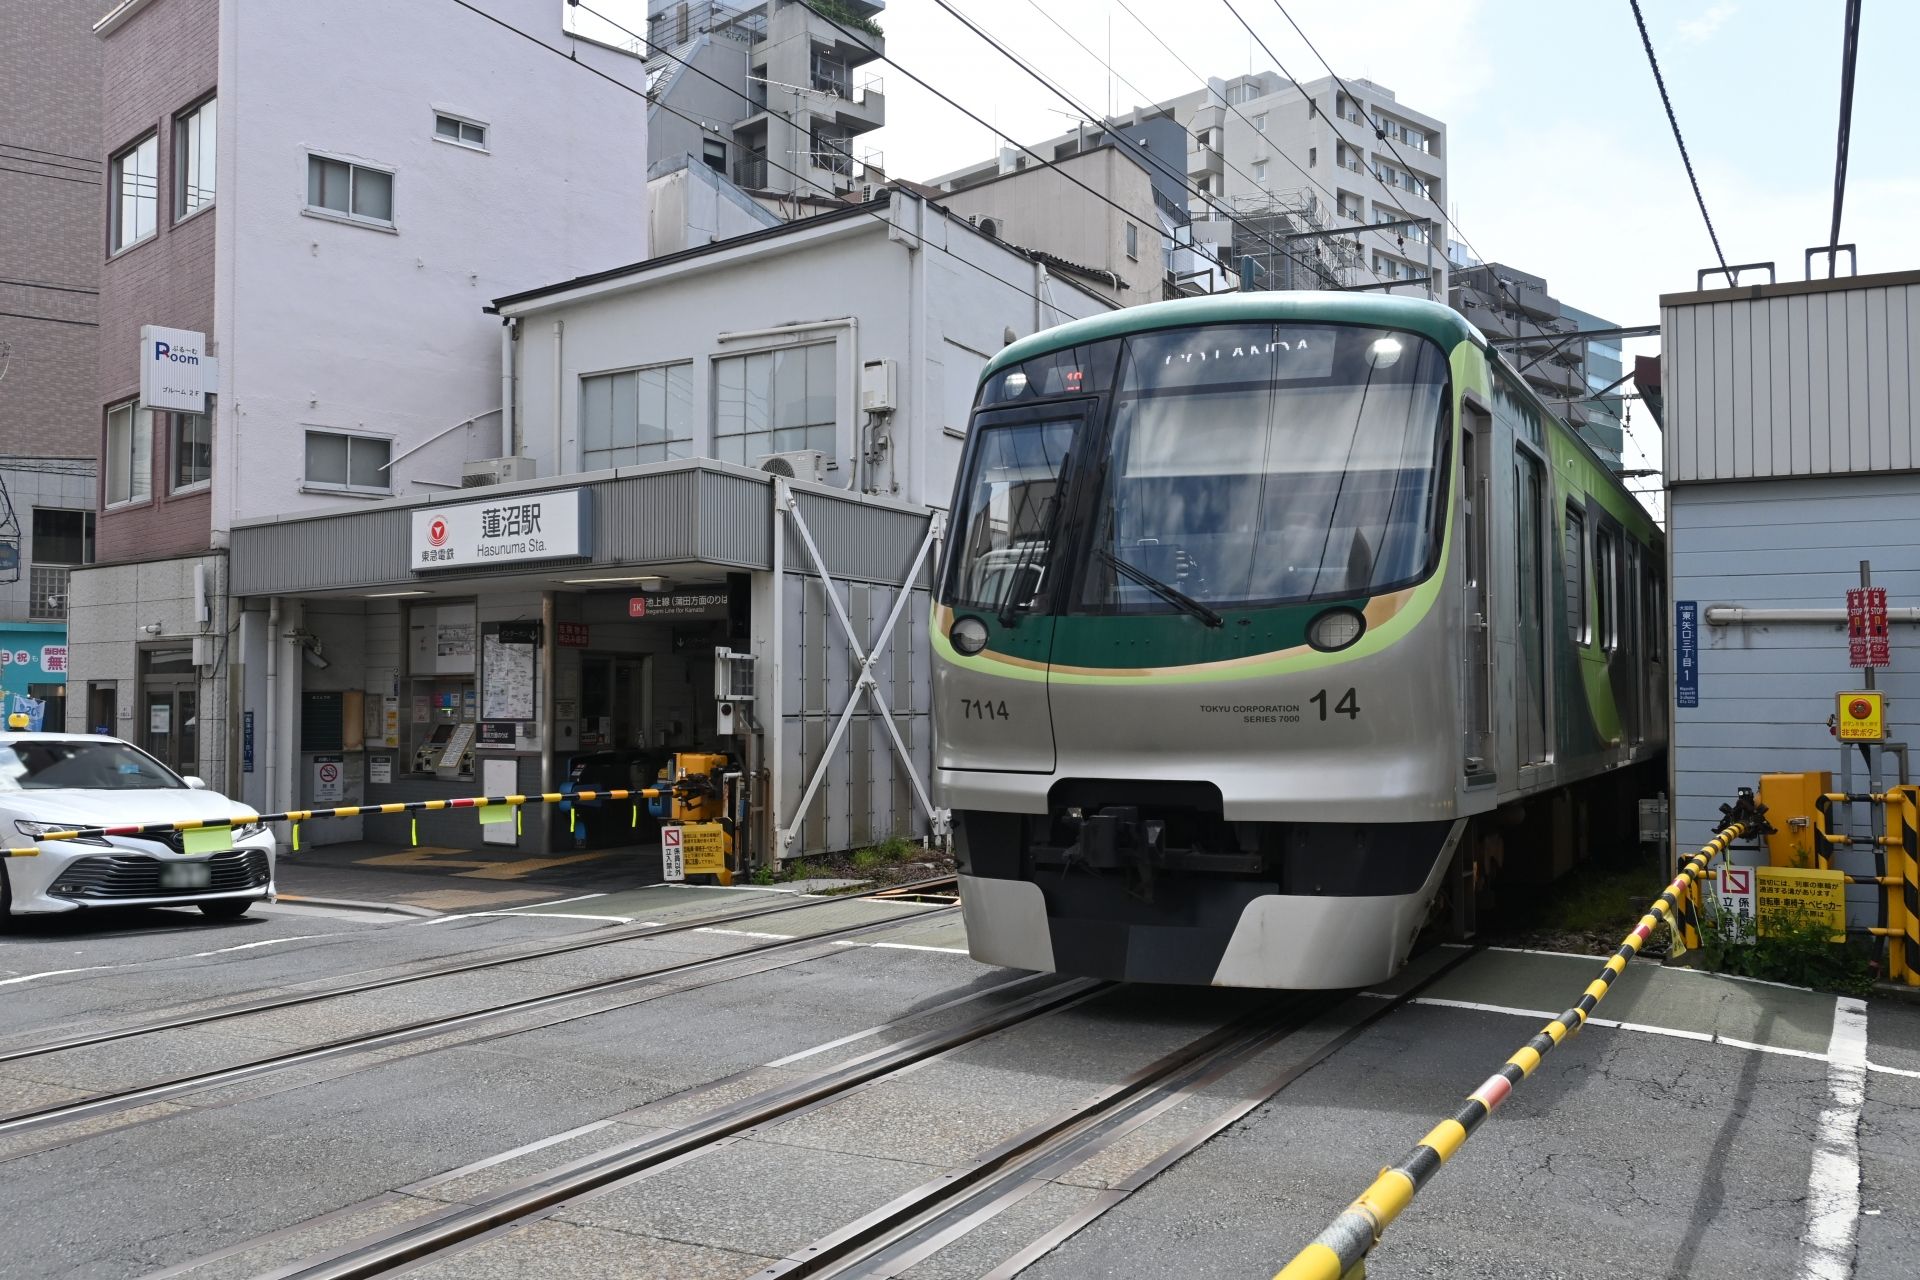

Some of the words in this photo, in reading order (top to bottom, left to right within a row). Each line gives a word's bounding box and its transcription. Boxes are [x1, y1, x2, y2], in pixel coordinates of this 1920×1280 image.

[482, 503, 541, 539] 蓮沼駅
[477, 541, 526, 557] Hasunuma
[528, 538, 548, 552] Sta.
[421, 548, 455, 562] 東急電鉄
[632, 603, 642, 612] IK
[1850, 608, 1863, 616] STOP
[1870, 607, 1884, 615] STOP
[1682, 612, 1692, 666] 東矢口三丁目
[47, 656, 67, 671] 無
[1684, 670, 1689, 681] 1
[961, 699, 1009, 721] 7114
[1200, 705, 1231, 713] TOKYU
[1232, 704, 1300, 713] CORPORATION
[1309, 687, 1361, 722] 14
[1243, 715, 1277, 723] SERIES
[1279, 715, 1300, 723] 7000
[1841, 728, 1880, 737] 非常ボタン
